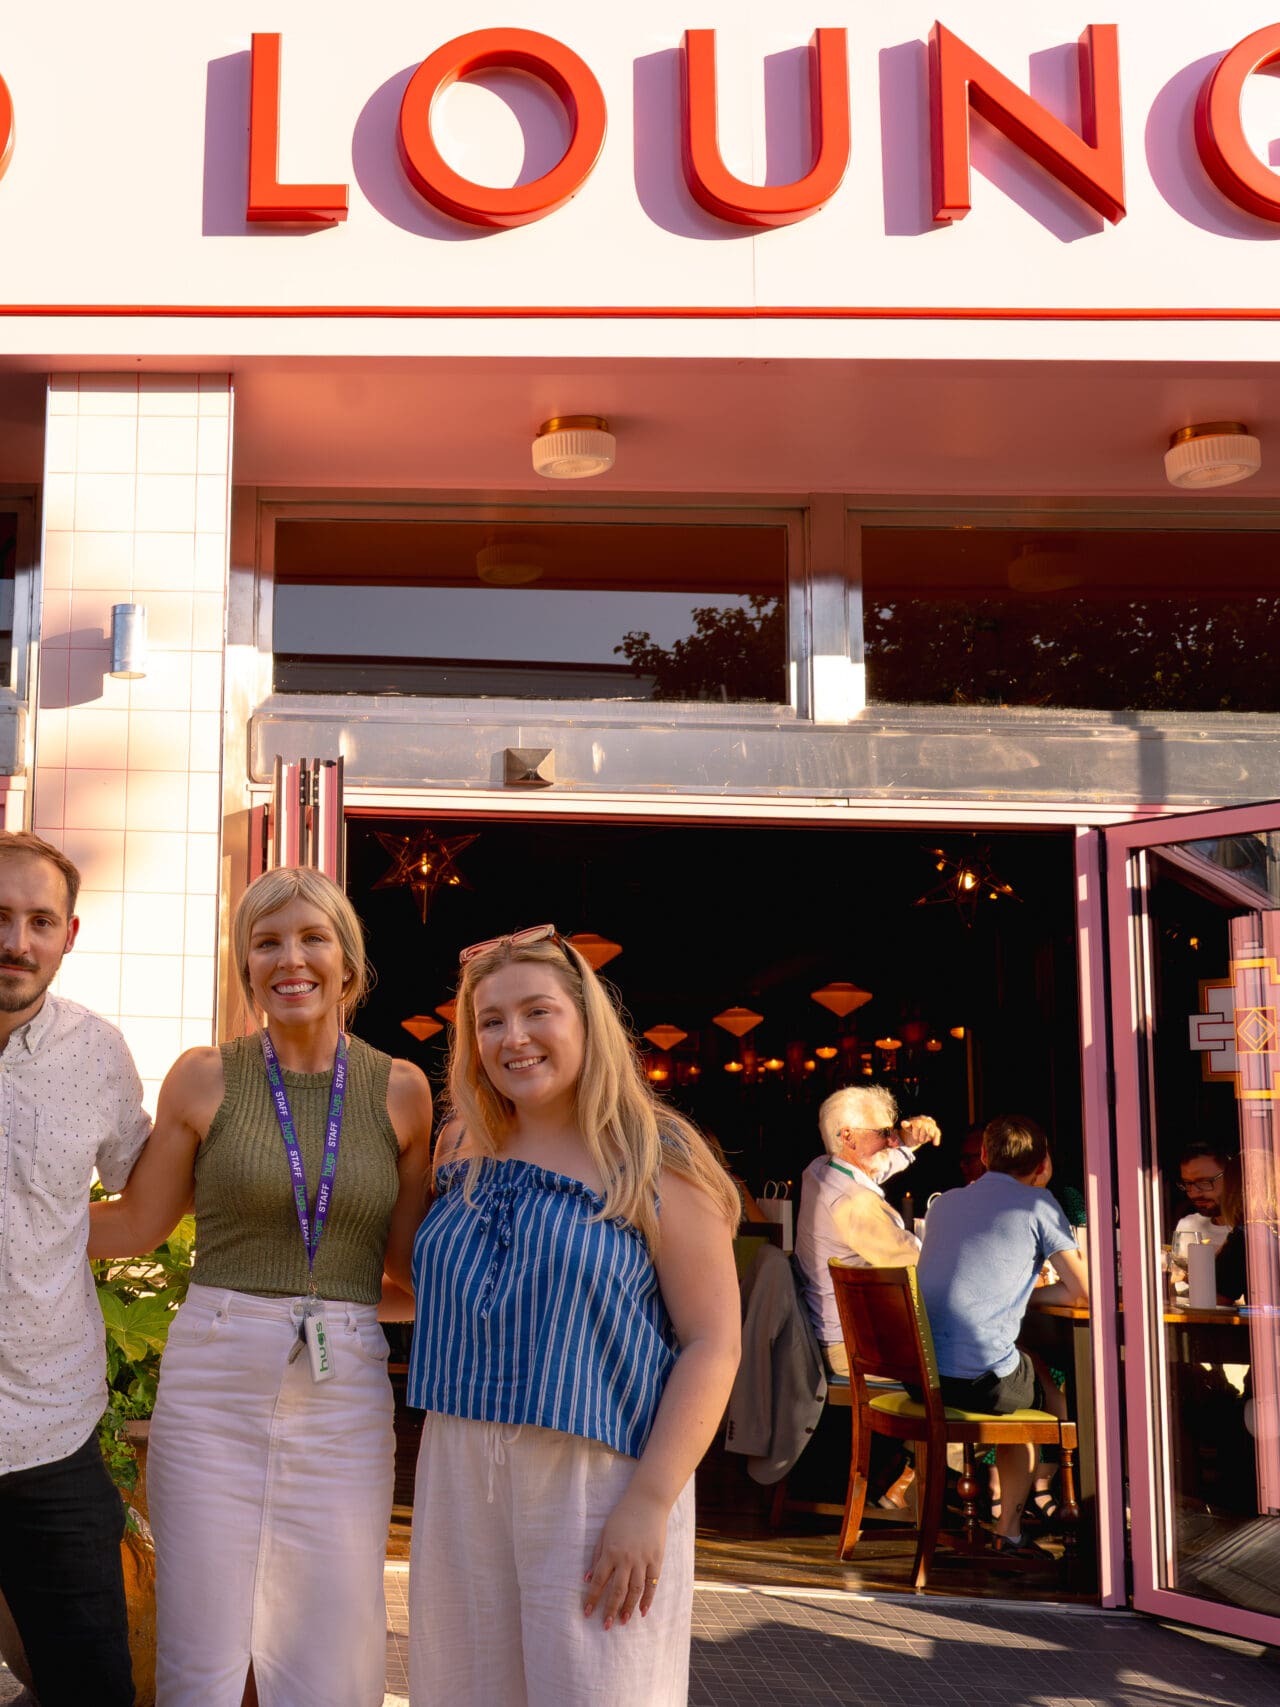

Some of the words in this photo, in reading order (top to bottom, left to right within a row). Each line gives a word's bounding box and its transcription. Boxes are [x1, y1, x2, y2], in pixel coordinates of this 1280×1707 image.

[335, 1063, 345, 1089] STAFF
[275, 1091, 289, 1117] STAFF
[327, 1121, 338, 1148] STAFF
[290, 1150, 303, 1178] STAFF
[321, 1152, 336, 1177] hugs
[295, 1184, 307, 1212] hugs
[318, 1183, 330, 1213] STAFF
[315, 1321, 329, 1372] hugs
